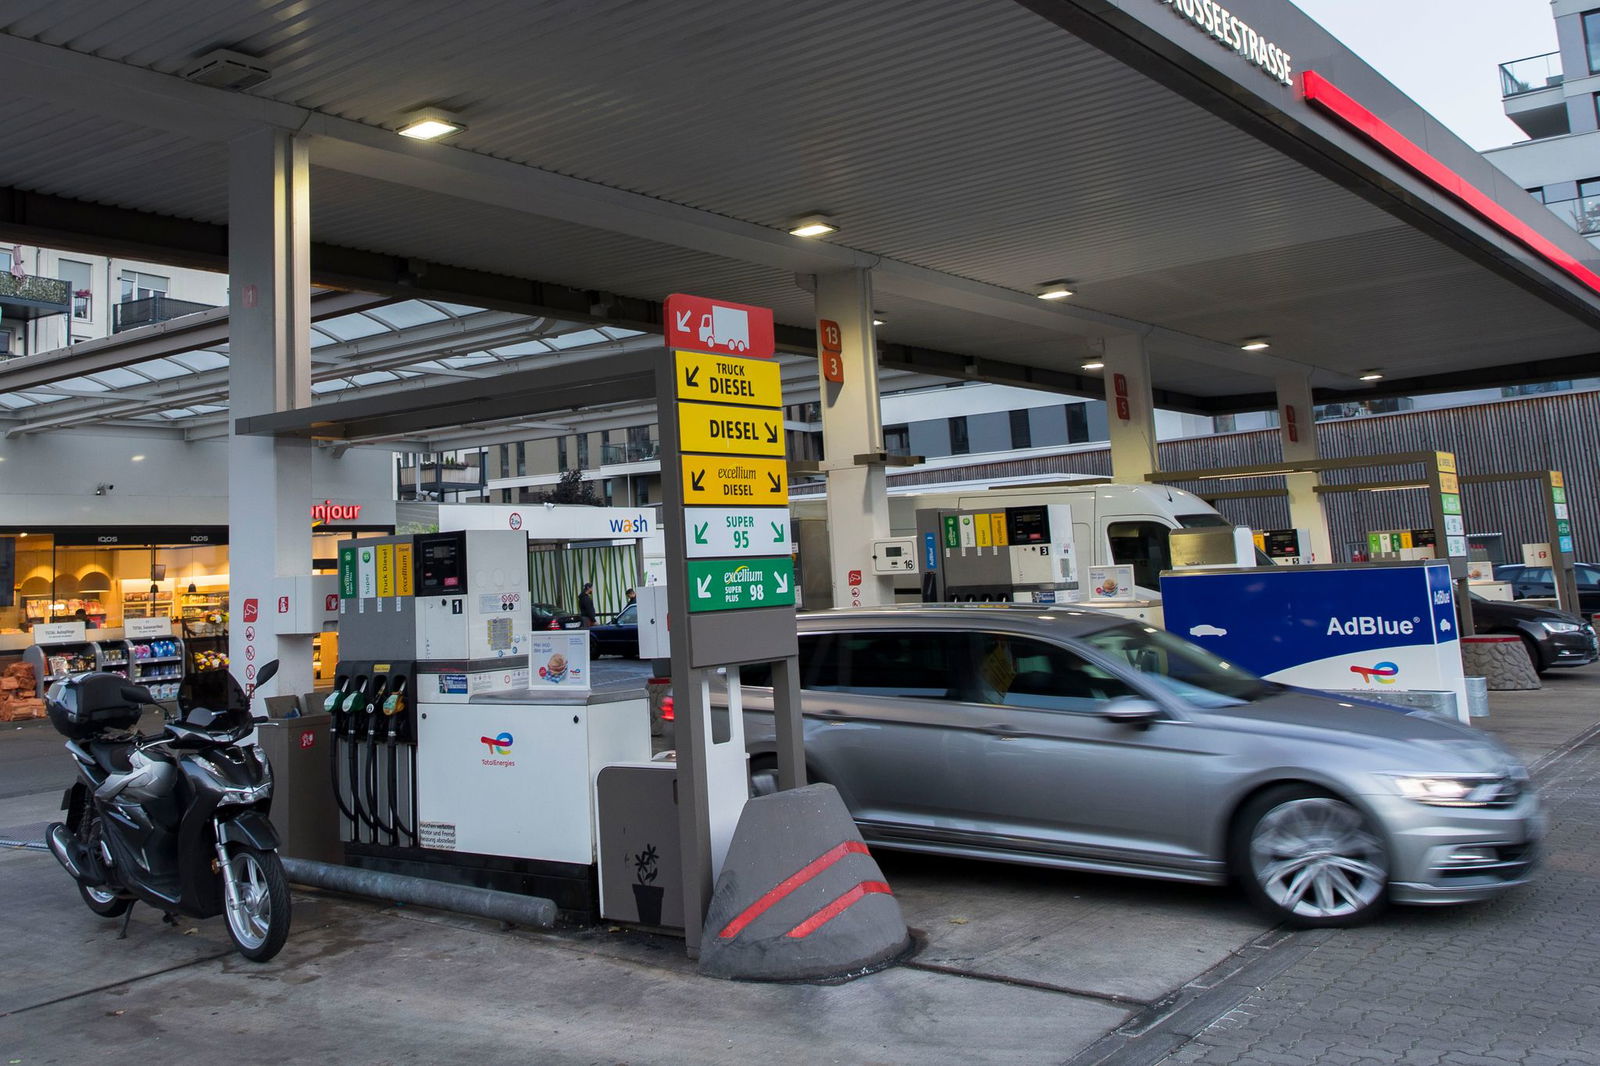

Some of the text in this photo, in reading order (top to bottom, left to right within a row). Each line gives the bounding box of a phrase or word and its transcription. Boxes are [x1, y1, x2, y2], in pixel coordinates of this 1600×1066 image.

[825, 326, 839, 344] 13
[716, 362, 745, 377] TRUCK
[831, 358, 838, 376] 3
[709, 377, 755, 397] DIESEL
[709, 419, 759, 441] DIESEL
[718, 465, 757, 480] excellium
[723, 484, 754, 496] DIESEL
[311, 499, 362, 525] njour
[609, 514, 648, 533] wash
[726, 515, 755, 528] SUPER
[733, 530, 750, 549] 95
[1042, 547, 1048, 555] 3
[903, 560, 913, 569] 16
[724, 569, 763, 583] excellium
[725, 584, 764, 601] SUPER 98
[725, 594, 739, 603] PLUS
[454, 600, 460, 613] 1
[482, 759, 515, 767] TotalEnergies
